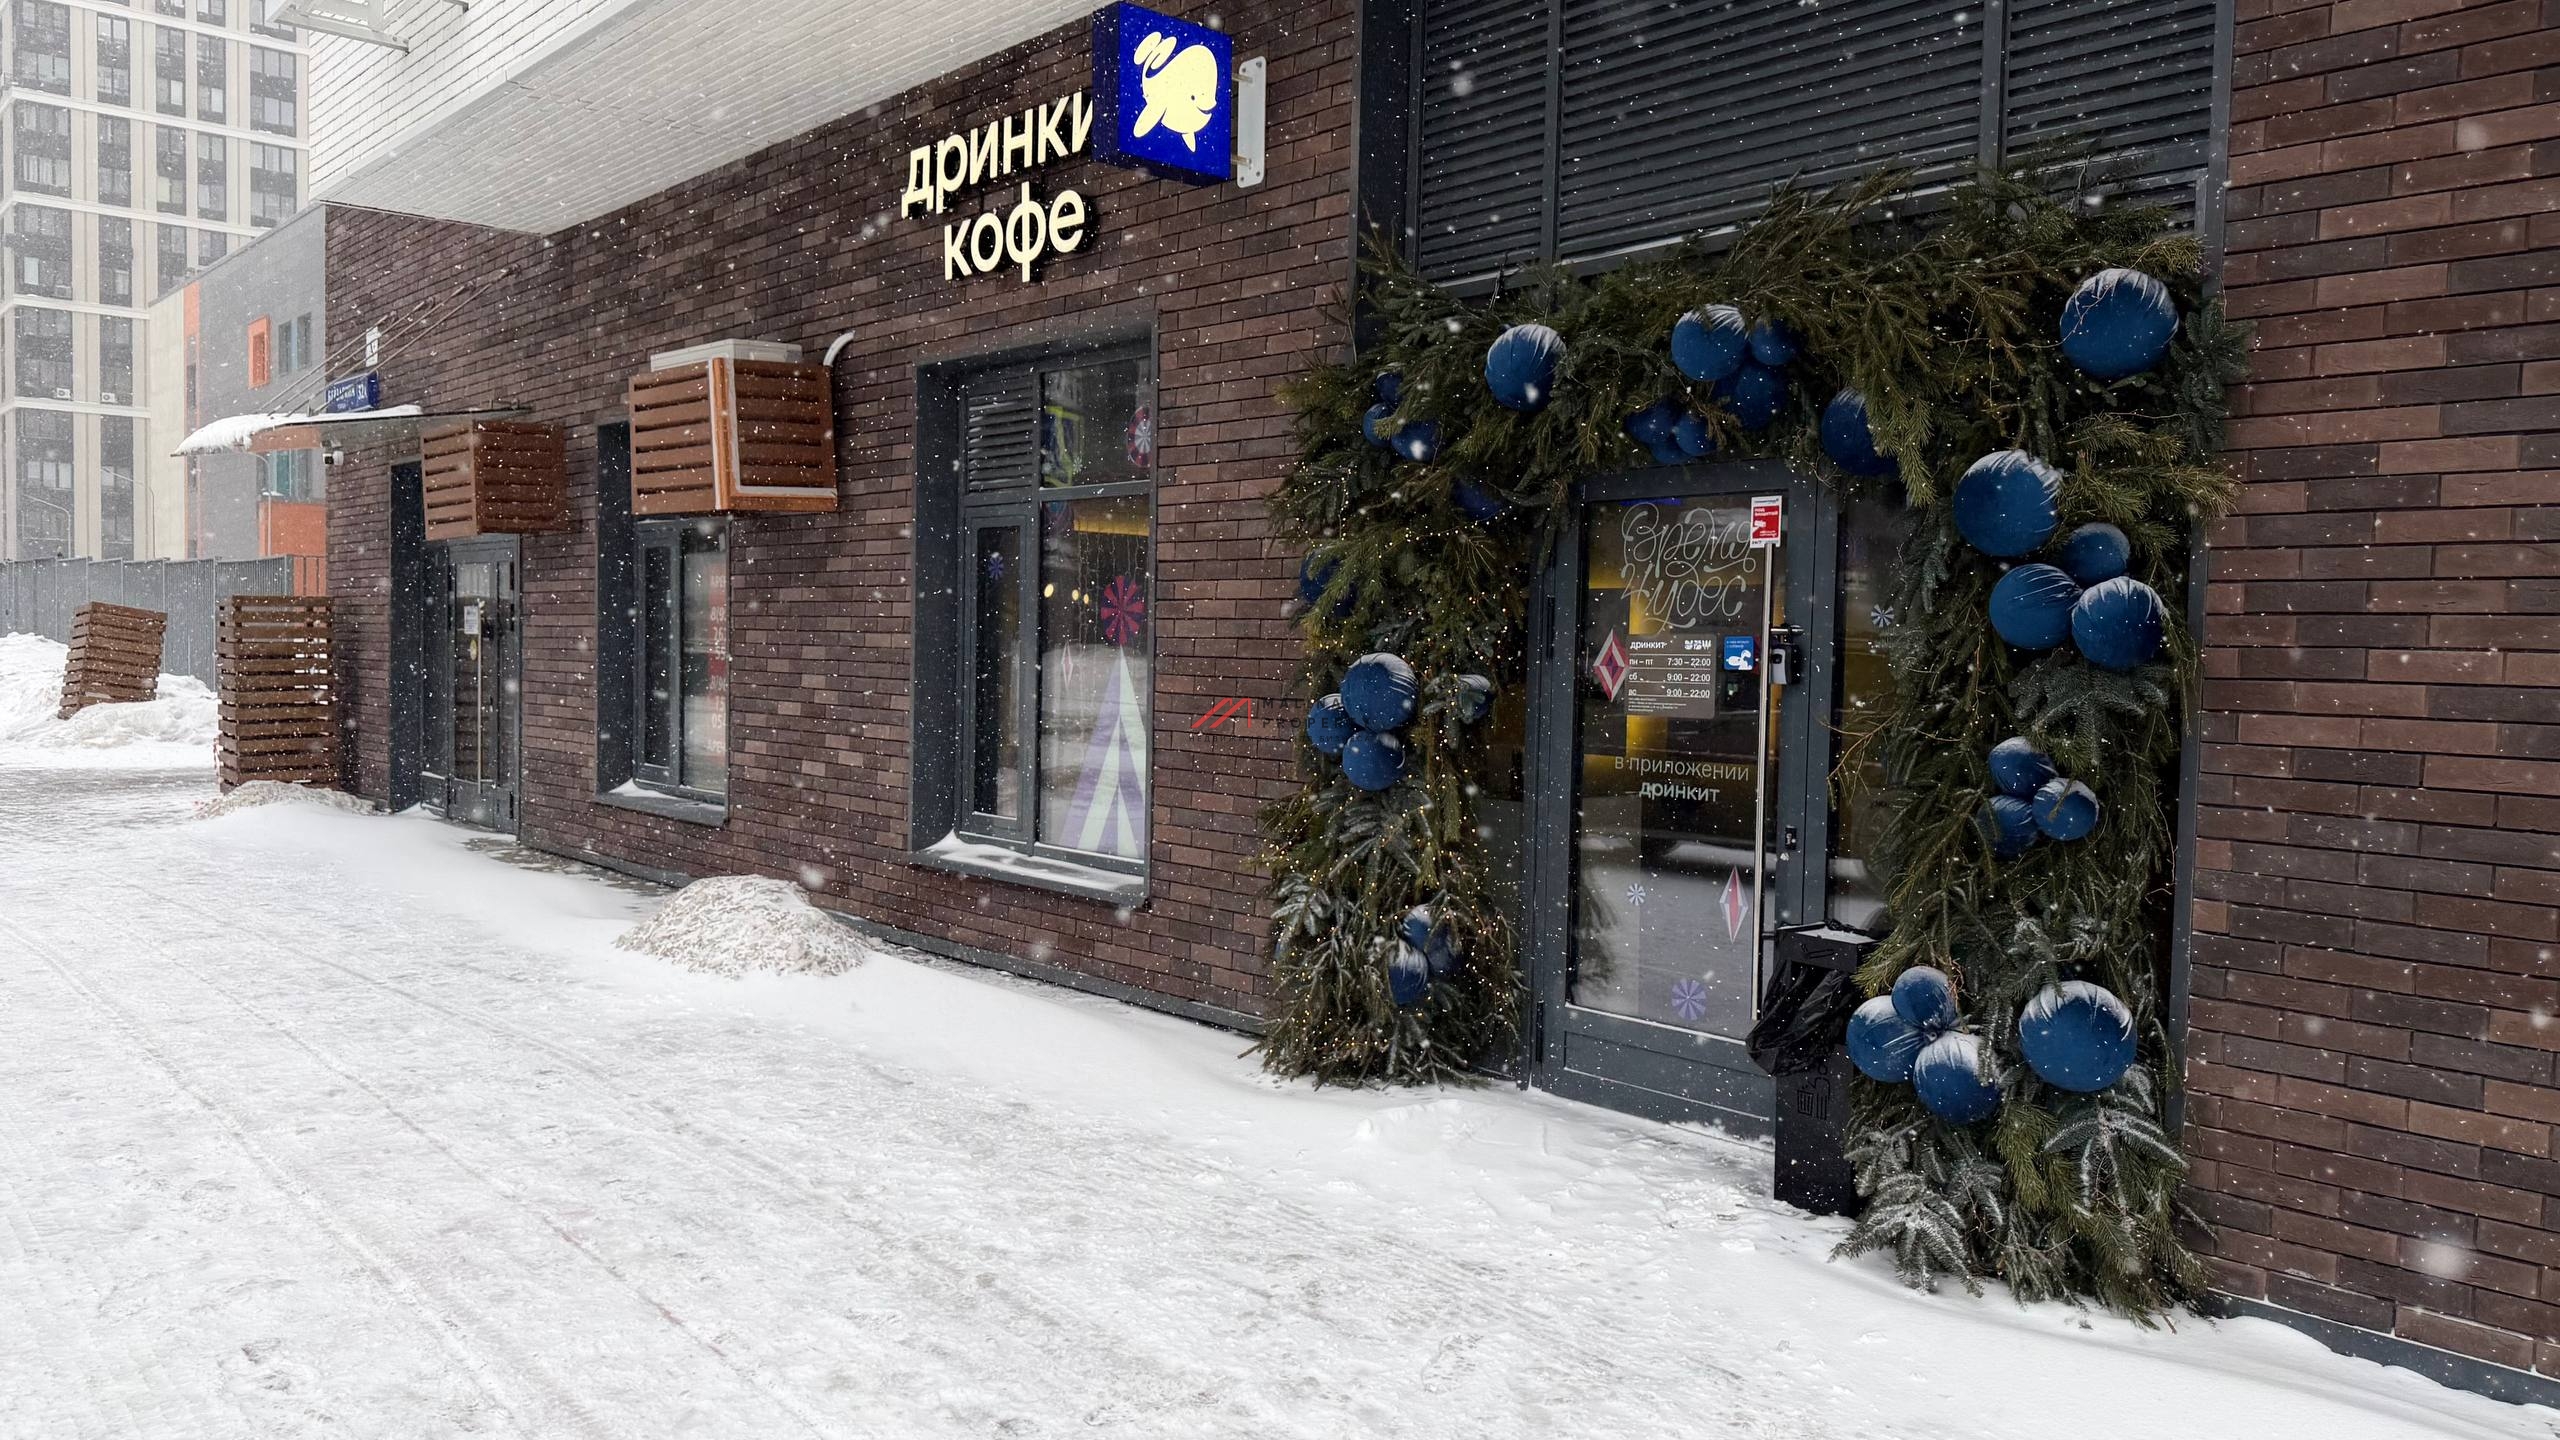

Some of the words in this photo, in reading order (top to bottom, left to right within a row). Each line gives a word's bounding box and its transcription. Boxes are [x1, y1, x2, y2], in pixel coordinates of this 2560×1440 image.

[901, 91, 1093, 219] дринки
[943, 181, 1086, 283] кофе
[1630, 641, 1666, 651] дринкит
[1667, 657, 1683, 666] 7:30
[1690, 658, 1711, 667] 22:00
[1628, 672, 1638, 681] сб
[1666, 673, 1683, 681] 9:00
[1690, 673, 1711, 682] 22:00
[1666, 688, 1682, 697] 9:00
[1690, 689, 1710, 698] 22:00
[1615, 756, 1624, 770] в
[1628, 757, 1750, 782] приложении
[1638, 781, 1721, 803] дринкит
